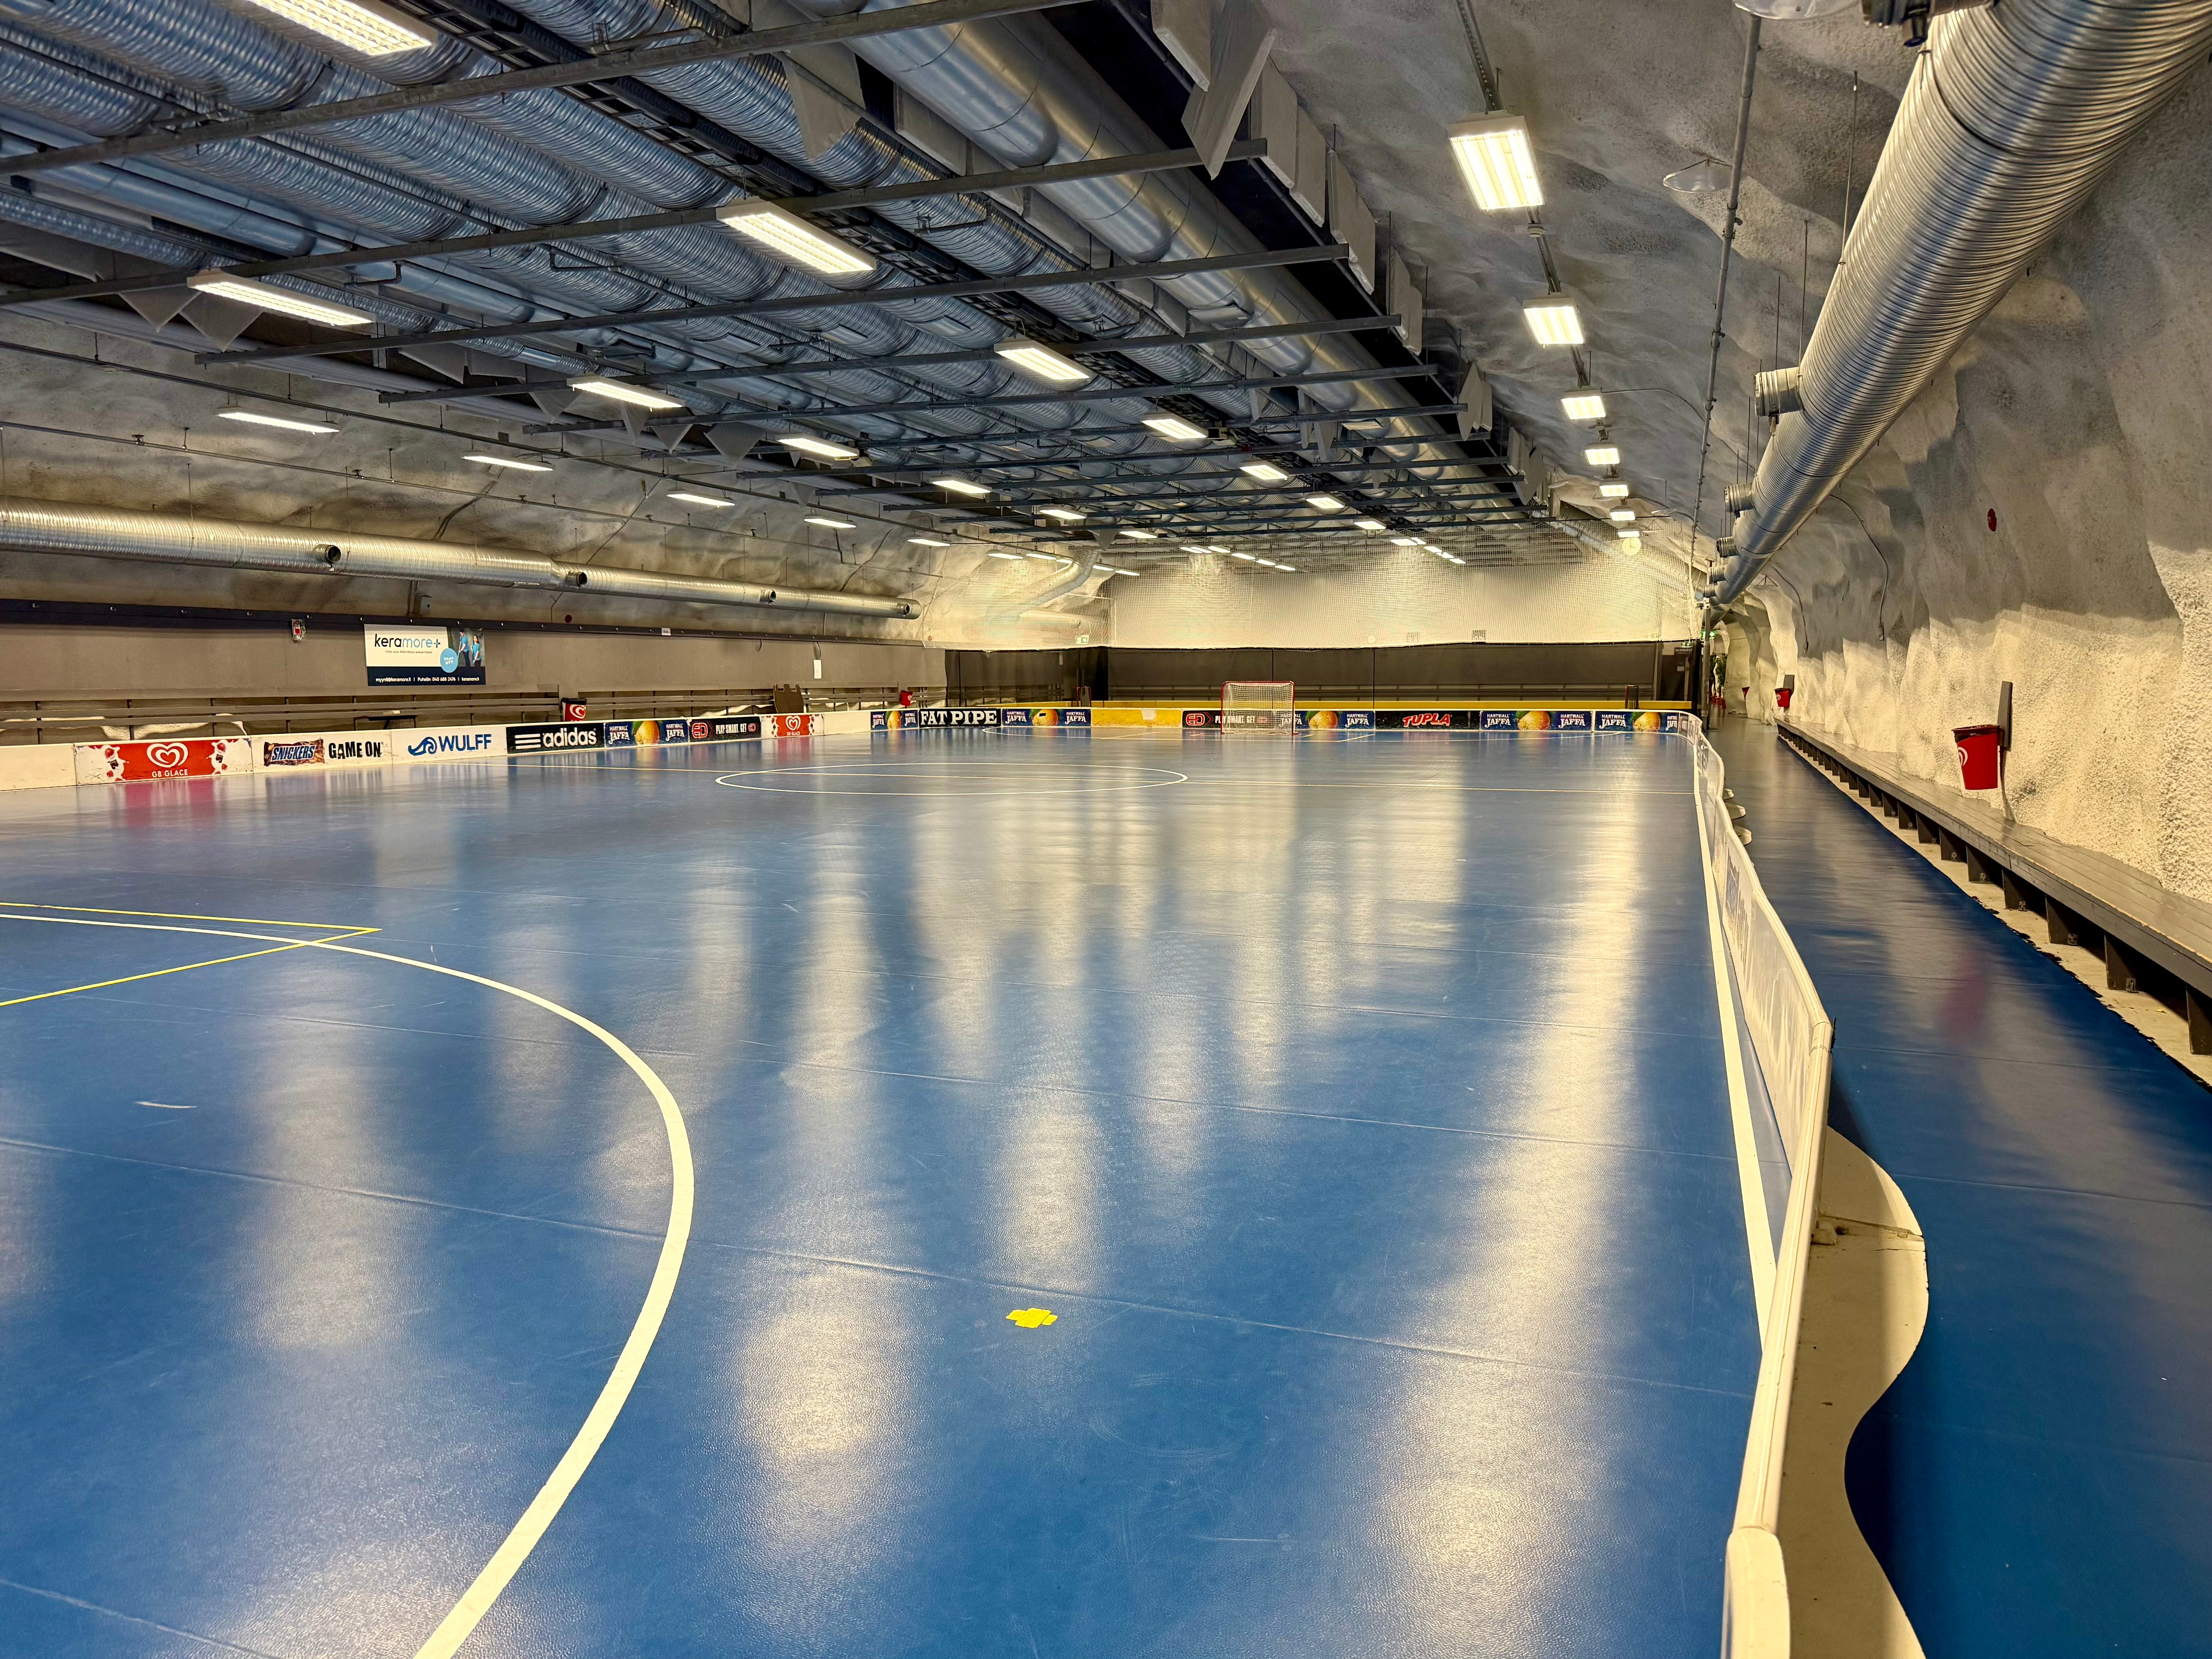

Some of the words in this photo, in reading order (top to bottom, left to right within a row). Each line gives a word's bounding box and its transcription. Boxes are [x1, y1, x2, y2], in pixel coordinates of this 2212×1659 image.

[374, 634, 441, 648] keramore+
[921, 711, 948, 725] FAT
[950, 710, 998, 725] PIPE
[1005, 715, 1027, 724] JAFFA
[1065, 716, 1087, 725] JAFFA
[1345, 718, 1369, 727] JAFFA
[1403, 713, 1450, 727] TUPLA
[1484, 718, 1511, 728] JAFFA
[1558, 719, 1585, 728] JAFFA
[1599, 719, 1626, 729] JAFFA
[543, 728, 596, 747] adidas
[609, 732, 630, 744] JAFFA
[666, 729, 685, 741] JAFFA
[438, 734, 492, 752] WULFF
[272, 746, 316, 760] SNICKERS
[328, 741, 363, 759] GAME
[365, 741, 381, 757] ON
